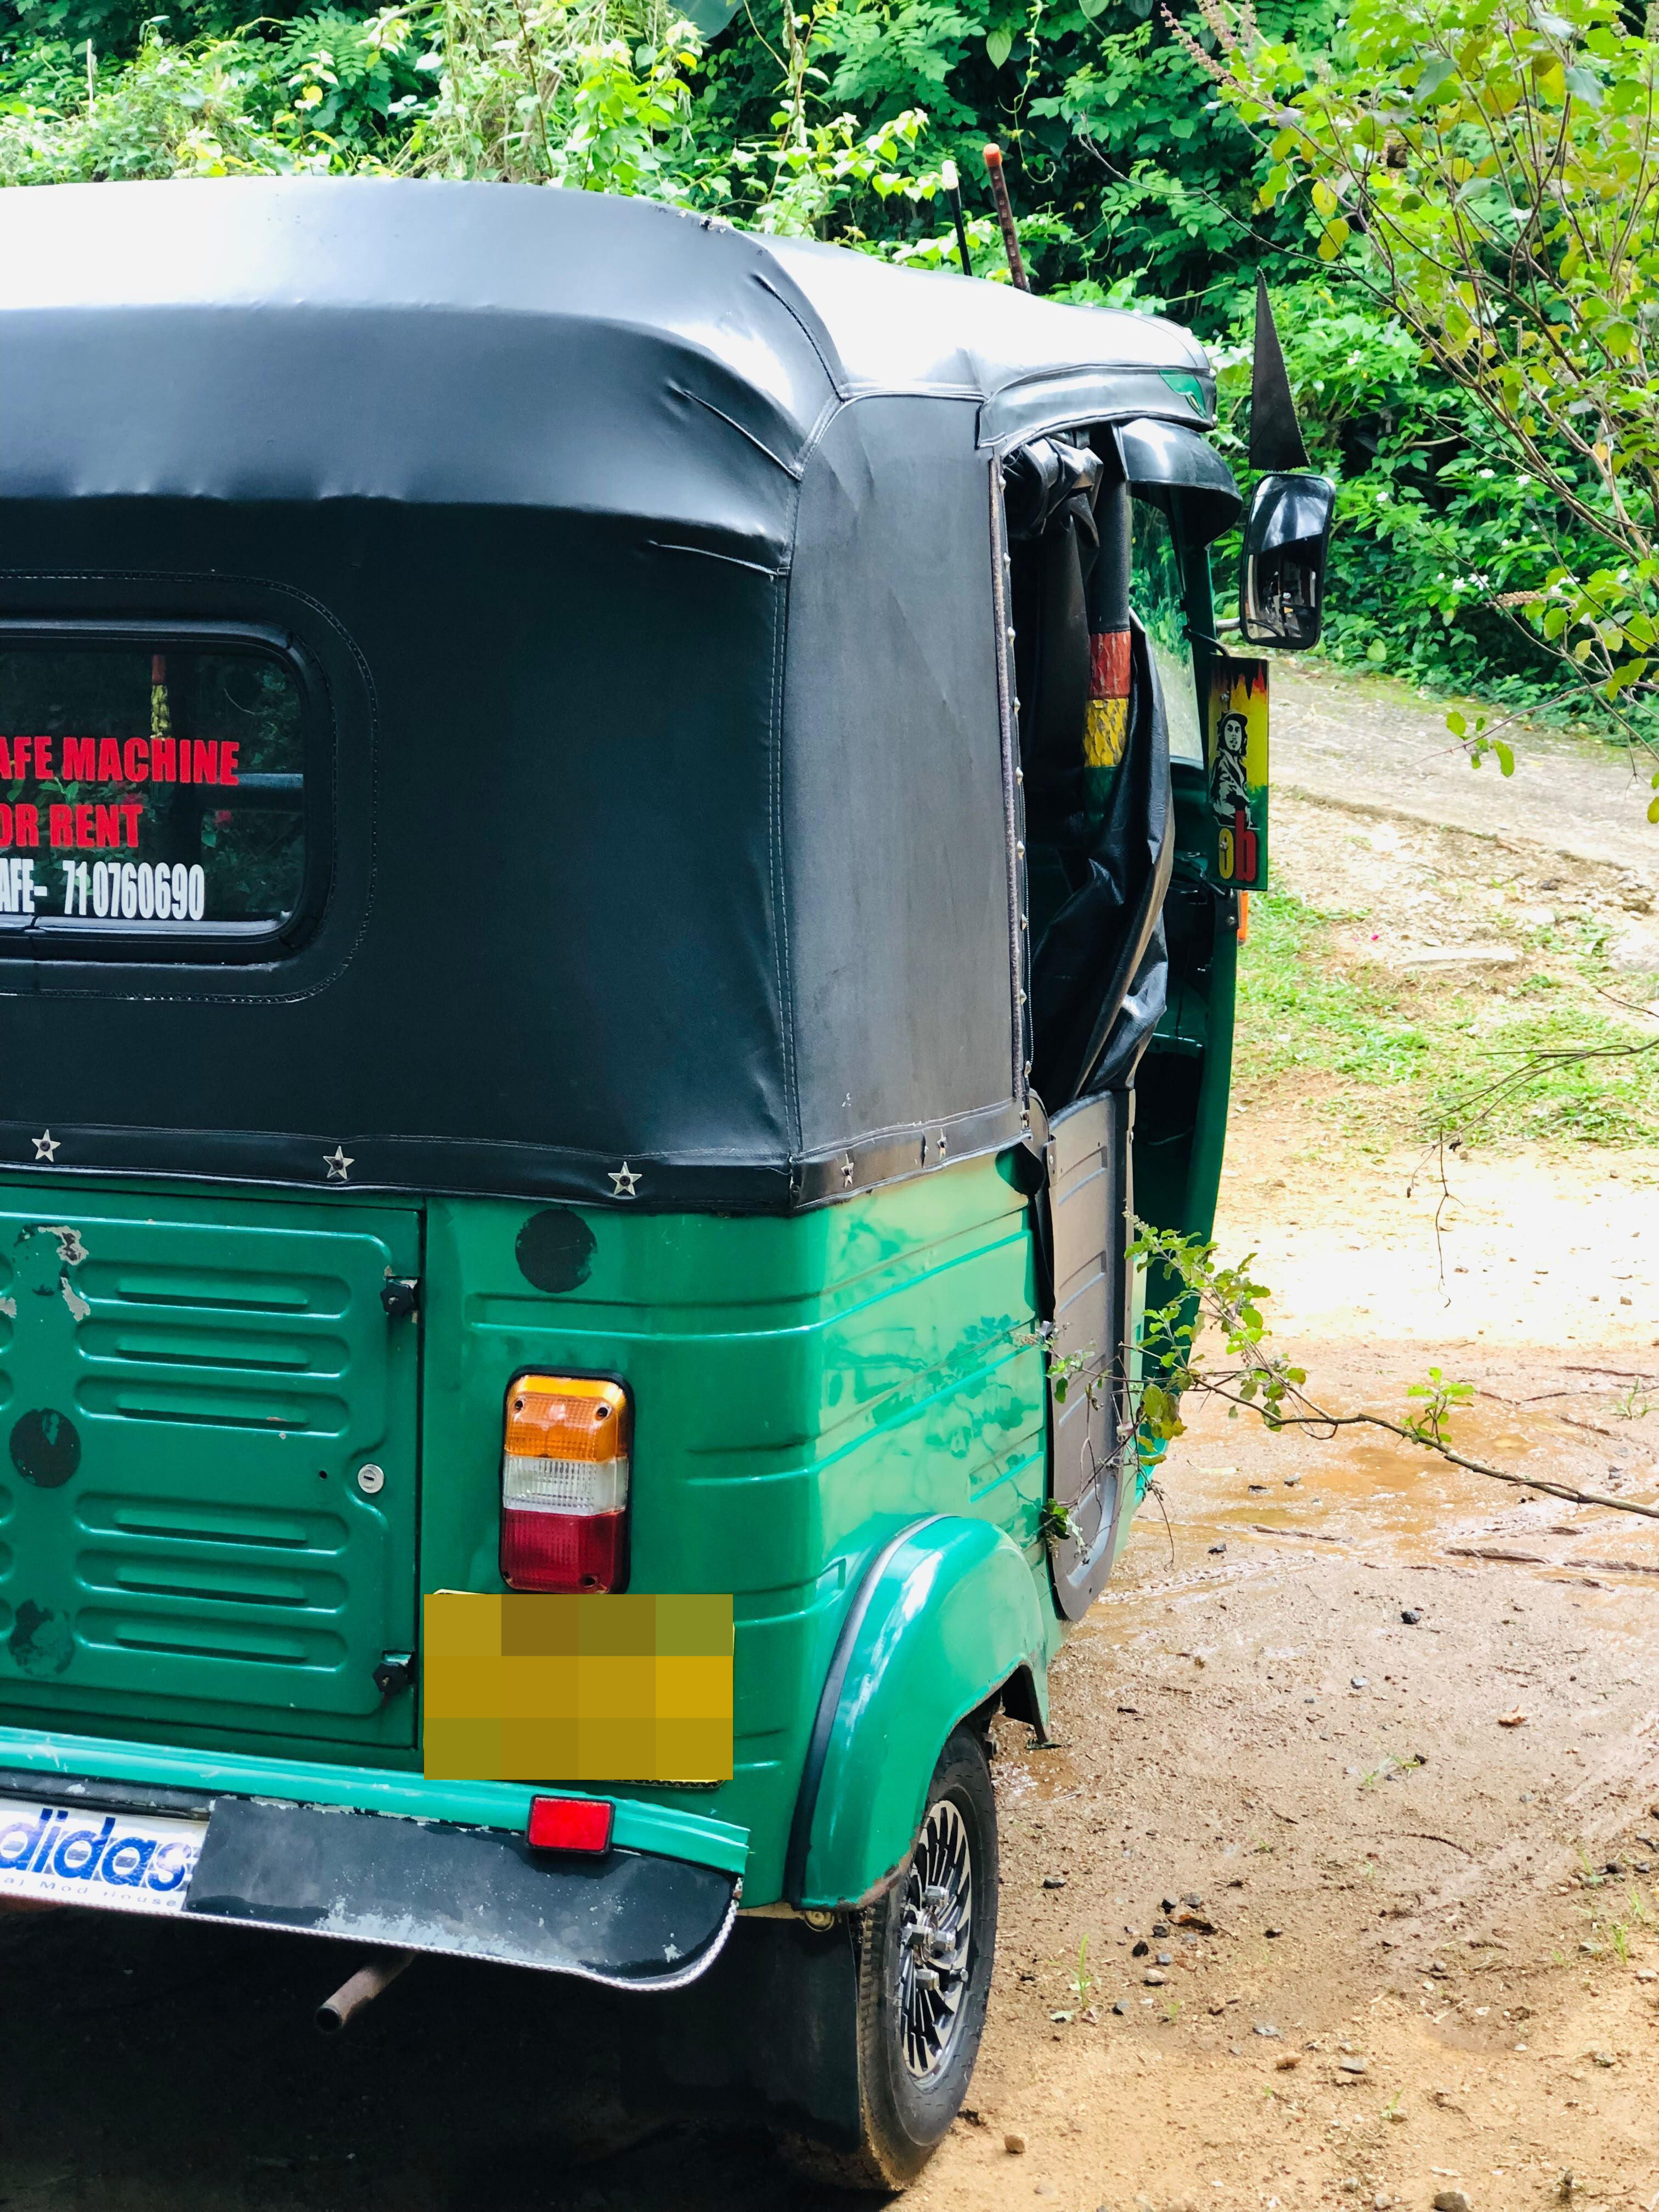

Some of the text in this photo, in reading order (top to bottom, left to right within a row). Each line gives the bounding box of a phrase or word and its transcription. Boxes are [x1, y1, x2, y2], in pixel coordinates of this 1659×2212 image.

[63, 737, 240, 786] MACHINE
[49, 804, 143, 848] RENT
[63, 860, 205, 921] 710760690
[40, 1881, 88, 1894] Mod
